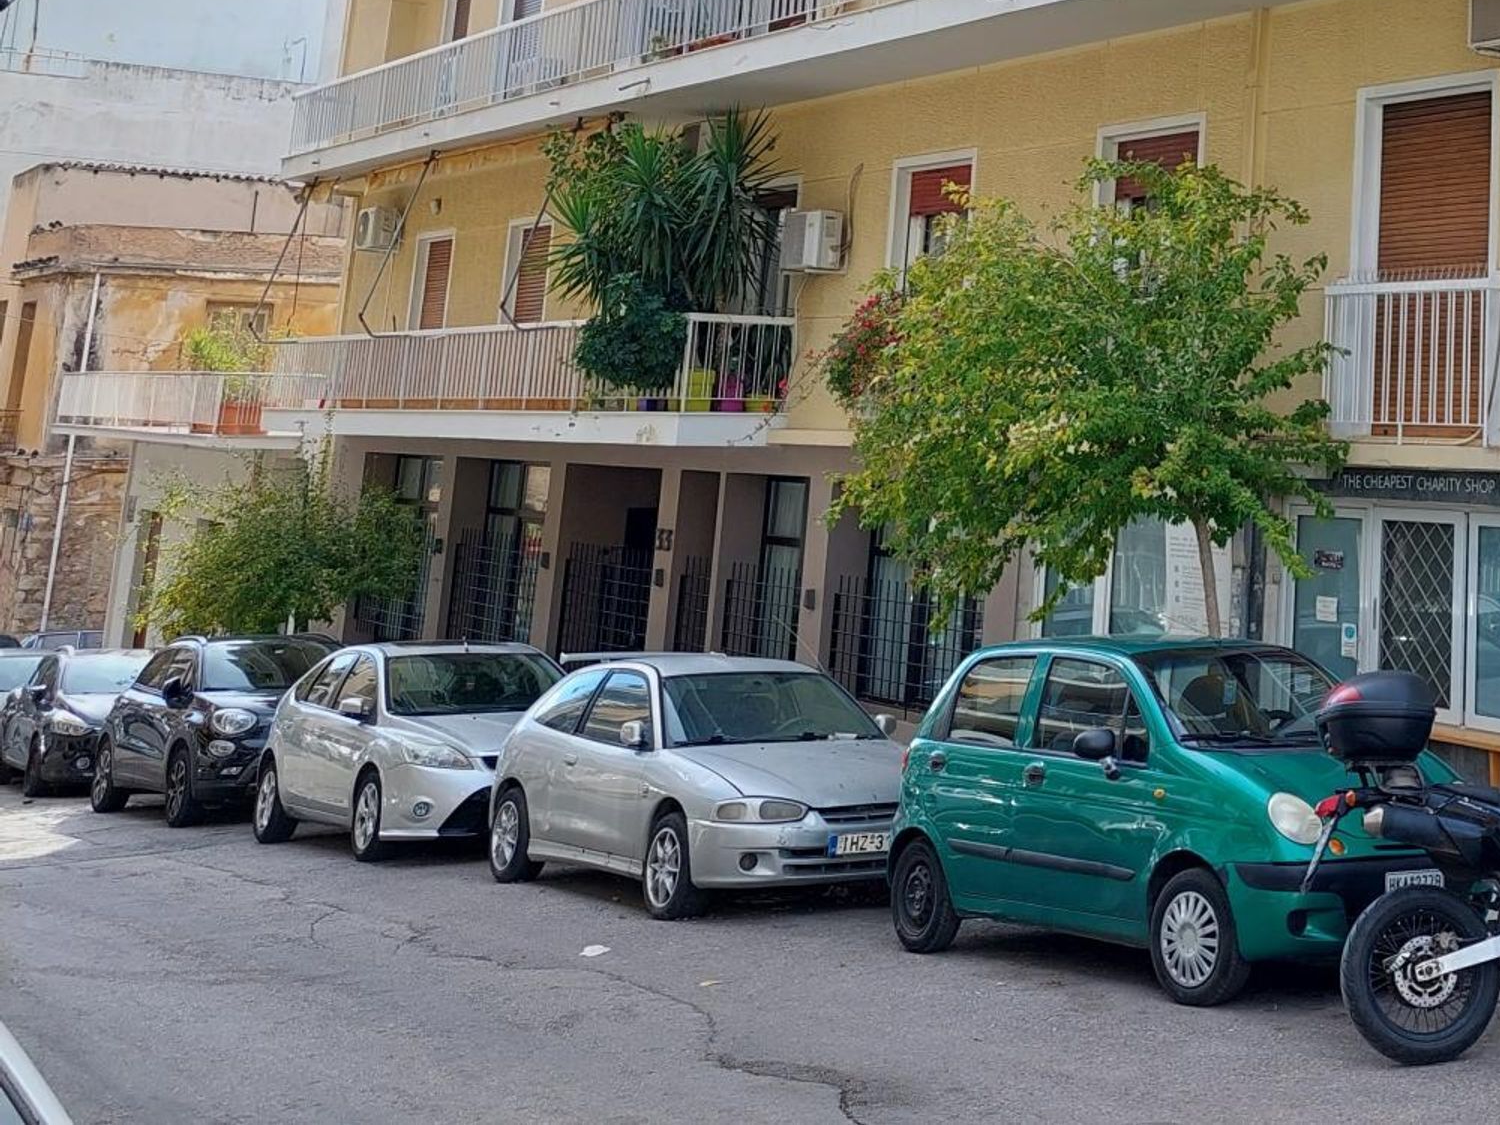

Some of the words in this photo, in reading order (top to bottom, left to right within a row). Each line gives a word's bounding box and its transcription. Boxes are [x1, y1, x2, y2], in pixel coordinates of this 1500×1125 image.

[1342, 474, 1361, 489] THE
[1363, 474, 1413, 489] CHEAPEST
[1416, 476, 1461, 492] CHARITY
[1464, 478, 1496, 493] SHOP
[656, 528, 673, 551] 33
